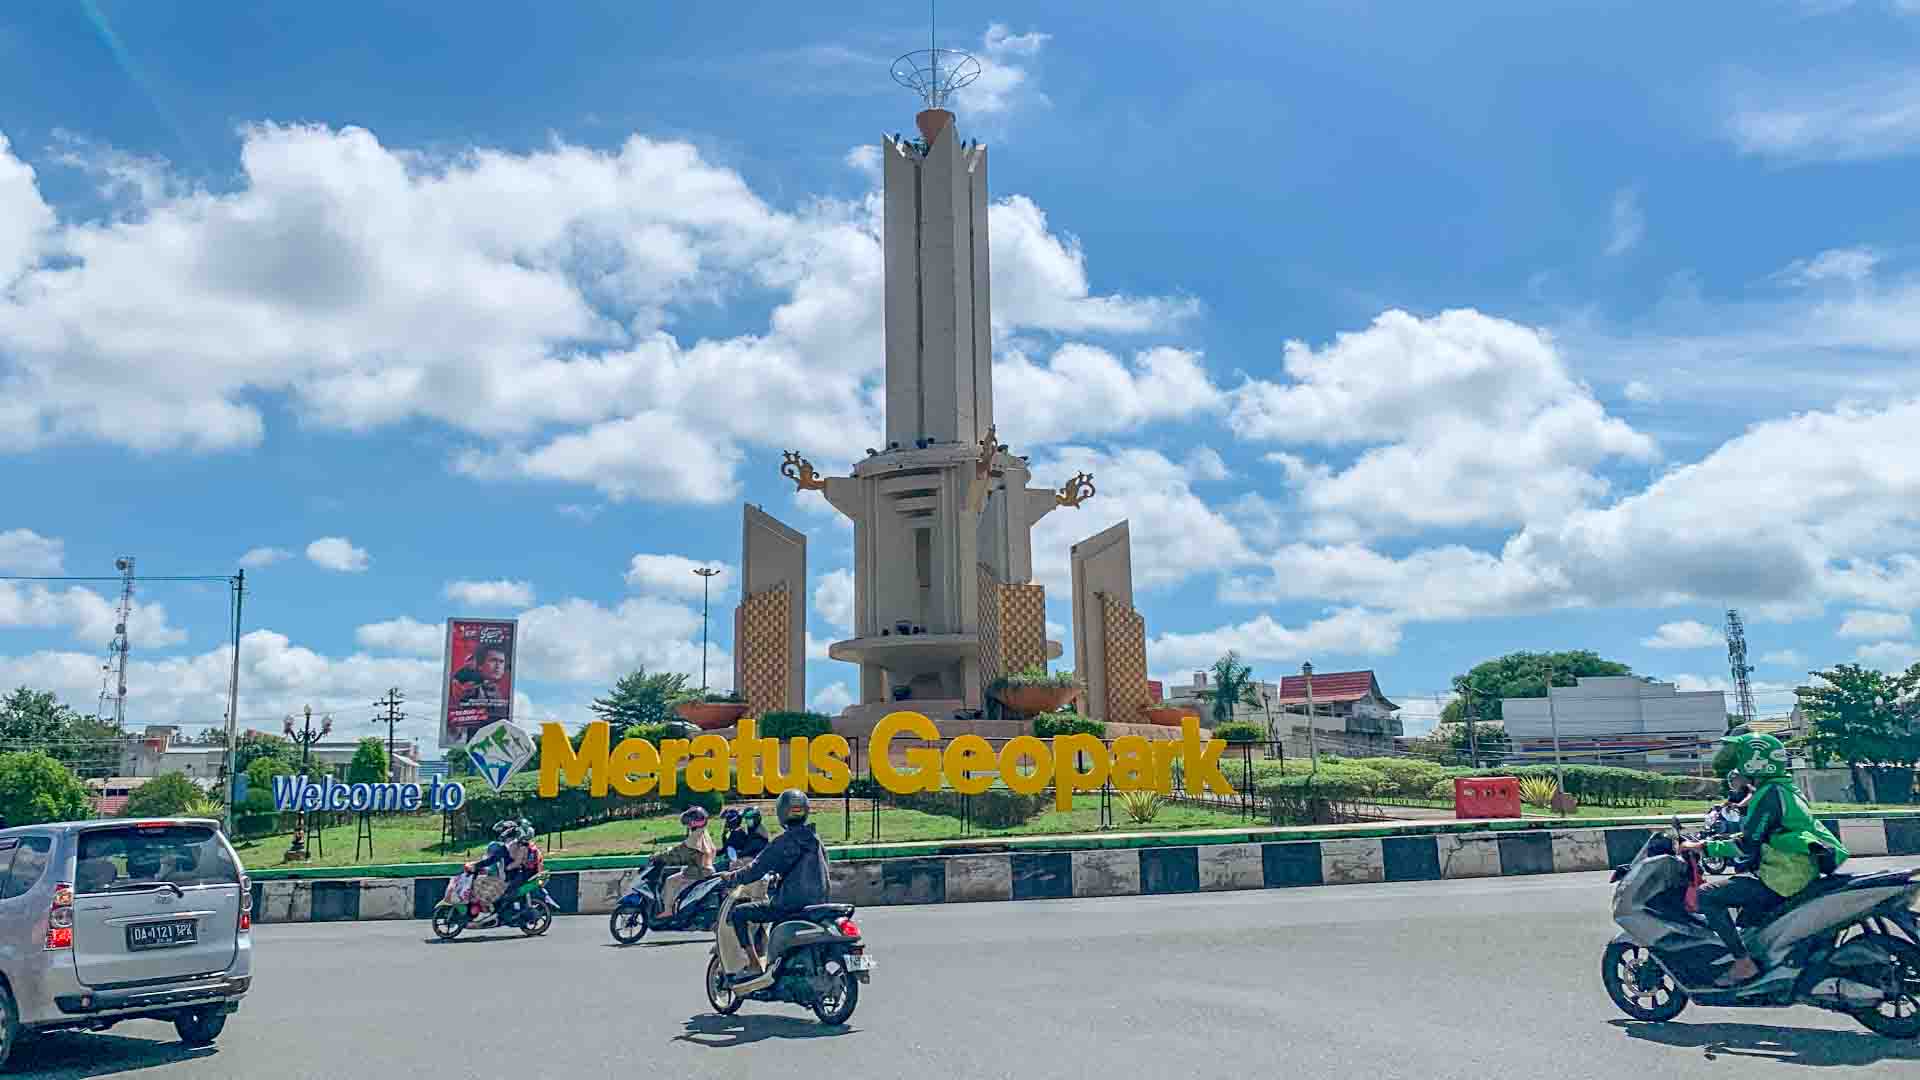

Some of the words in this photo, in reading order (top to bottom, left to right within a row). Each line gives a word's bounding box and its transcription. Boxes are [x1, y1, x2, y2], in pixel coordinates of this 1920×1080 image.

[538, 719, 850, 798] Meratus
[868, 711, 1235, 812] Geopark
[273, 774, 422, 811] Welcome
[429, 773, 465, 811] to
[134, 927, 147, 940] DA
[151, 926, 173, 938] 1121
